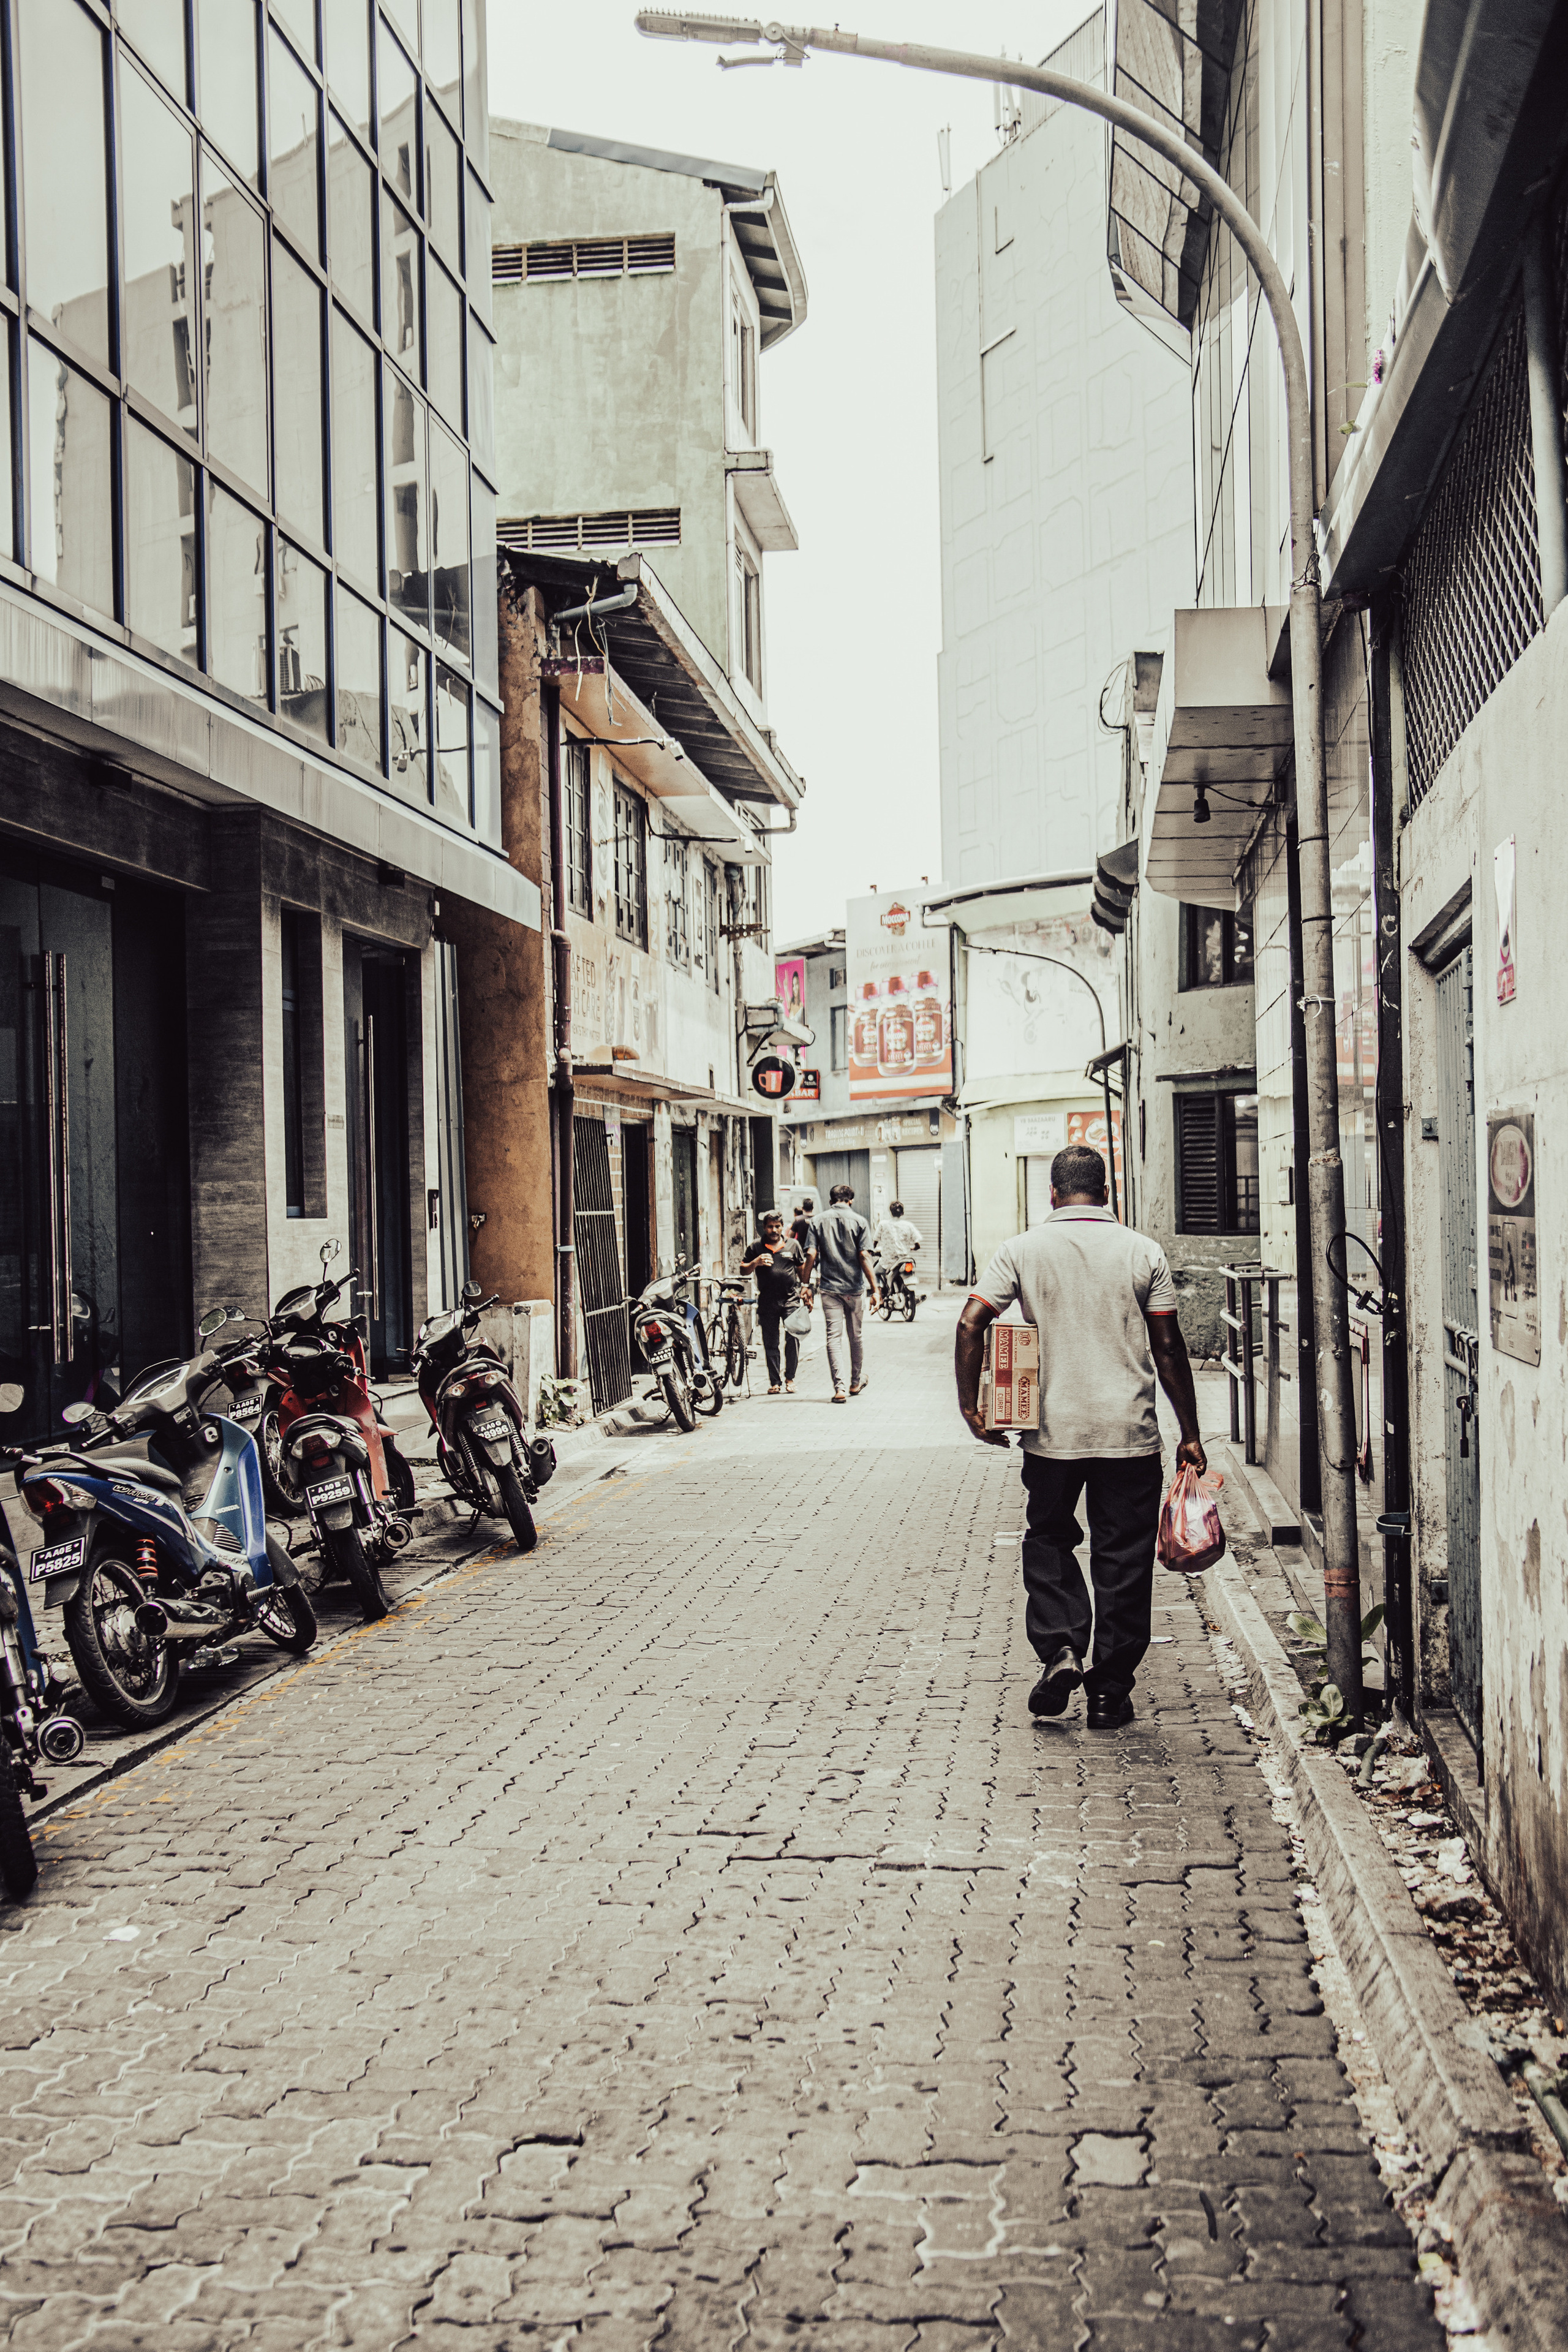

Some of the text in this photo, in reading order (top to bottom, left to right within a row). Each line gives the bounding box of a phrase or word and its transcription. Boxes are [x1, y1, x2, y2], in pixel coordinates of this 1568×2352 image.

[881, 912, 909, 925] MOCCONA
[856, 938, 935, 959] DISCOVER A COFFEE
[571, 952, 596, 989] AFTED
[581, 989, 600, 1022] CARE
[825, 1129, 844, 1139] TRADING
[901, 1126, 924, 1136] RECIPES
[998, 1330, 1009, 1370] MAMEE
[230, 1404, 260, 1419] P8564
[112, 1484, 156, 1501] WAVE
[311, 1486, 350, 1504] P9259
[215, 1504, 240, 1515] HONDA
[35, 1551, 80, 1578] P5825
